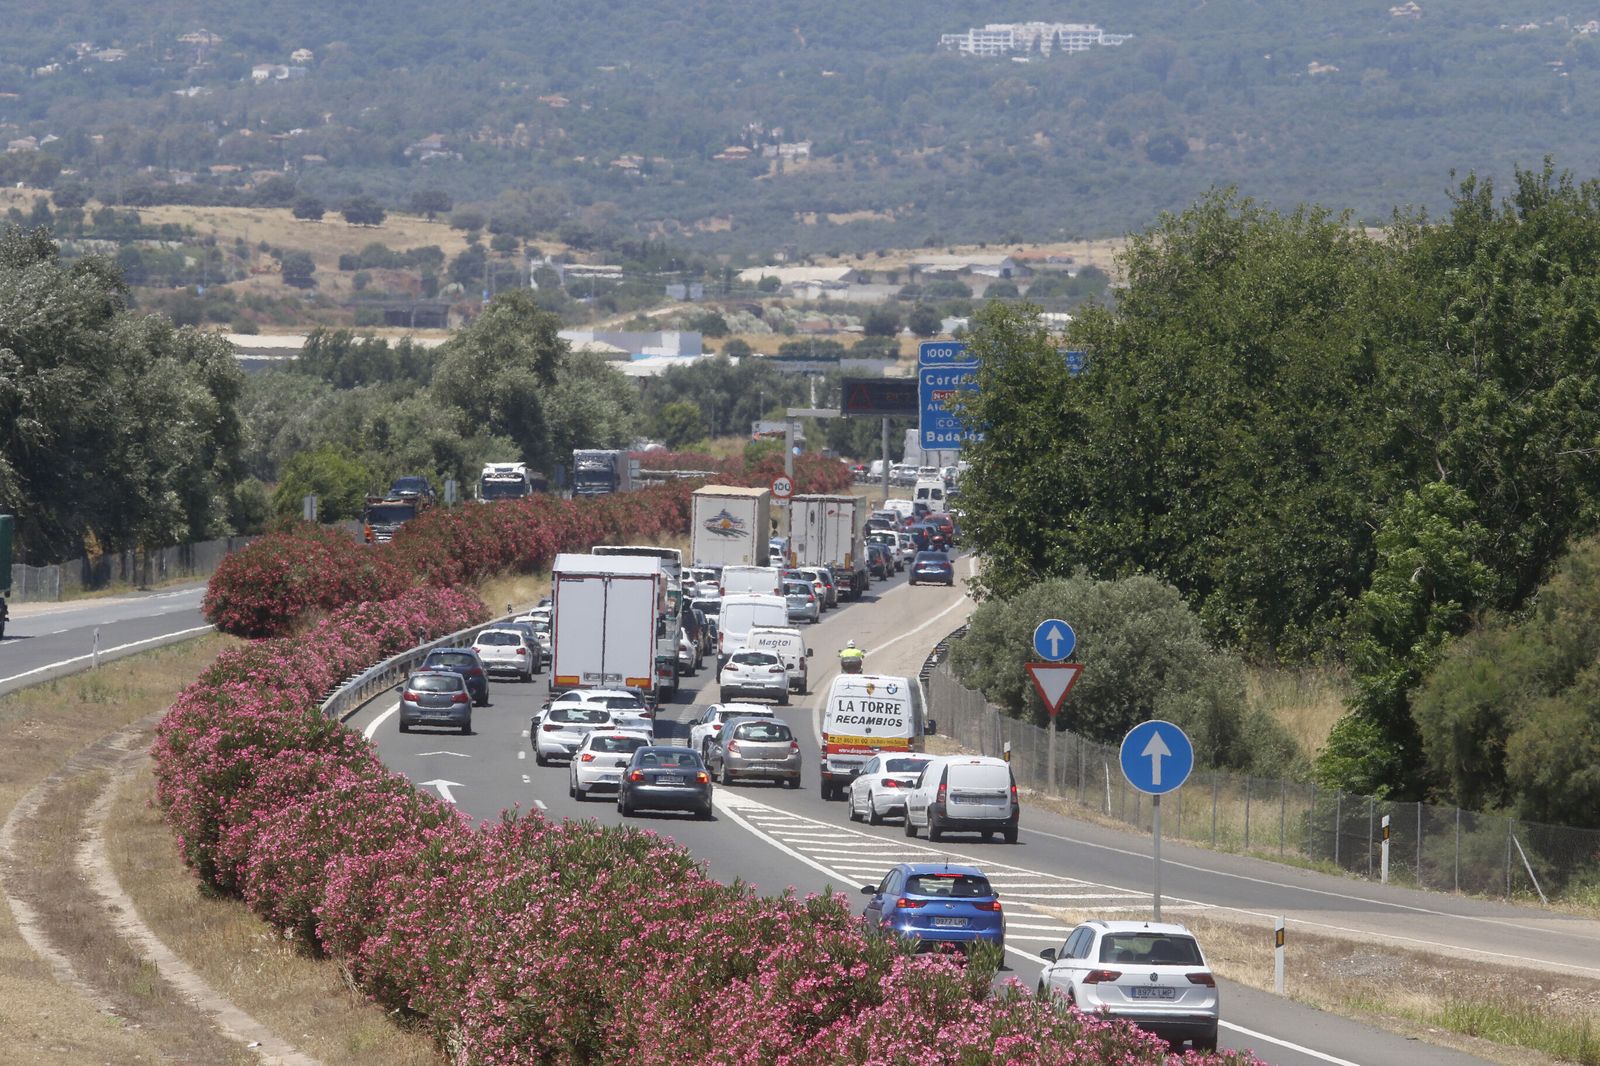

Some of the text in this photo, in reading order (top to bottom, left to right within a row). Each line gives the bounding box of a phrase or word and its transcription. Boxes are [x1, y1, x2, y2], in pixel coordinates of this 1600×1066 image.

[927, 349, 953, 358] 1000
[774, 482, 791, 492] 100
[758, 639, 792, 649] Magtel
[838, 699, 902, 716] LA TORRE
[835, 715, 903, 727] RECAMBIOS
